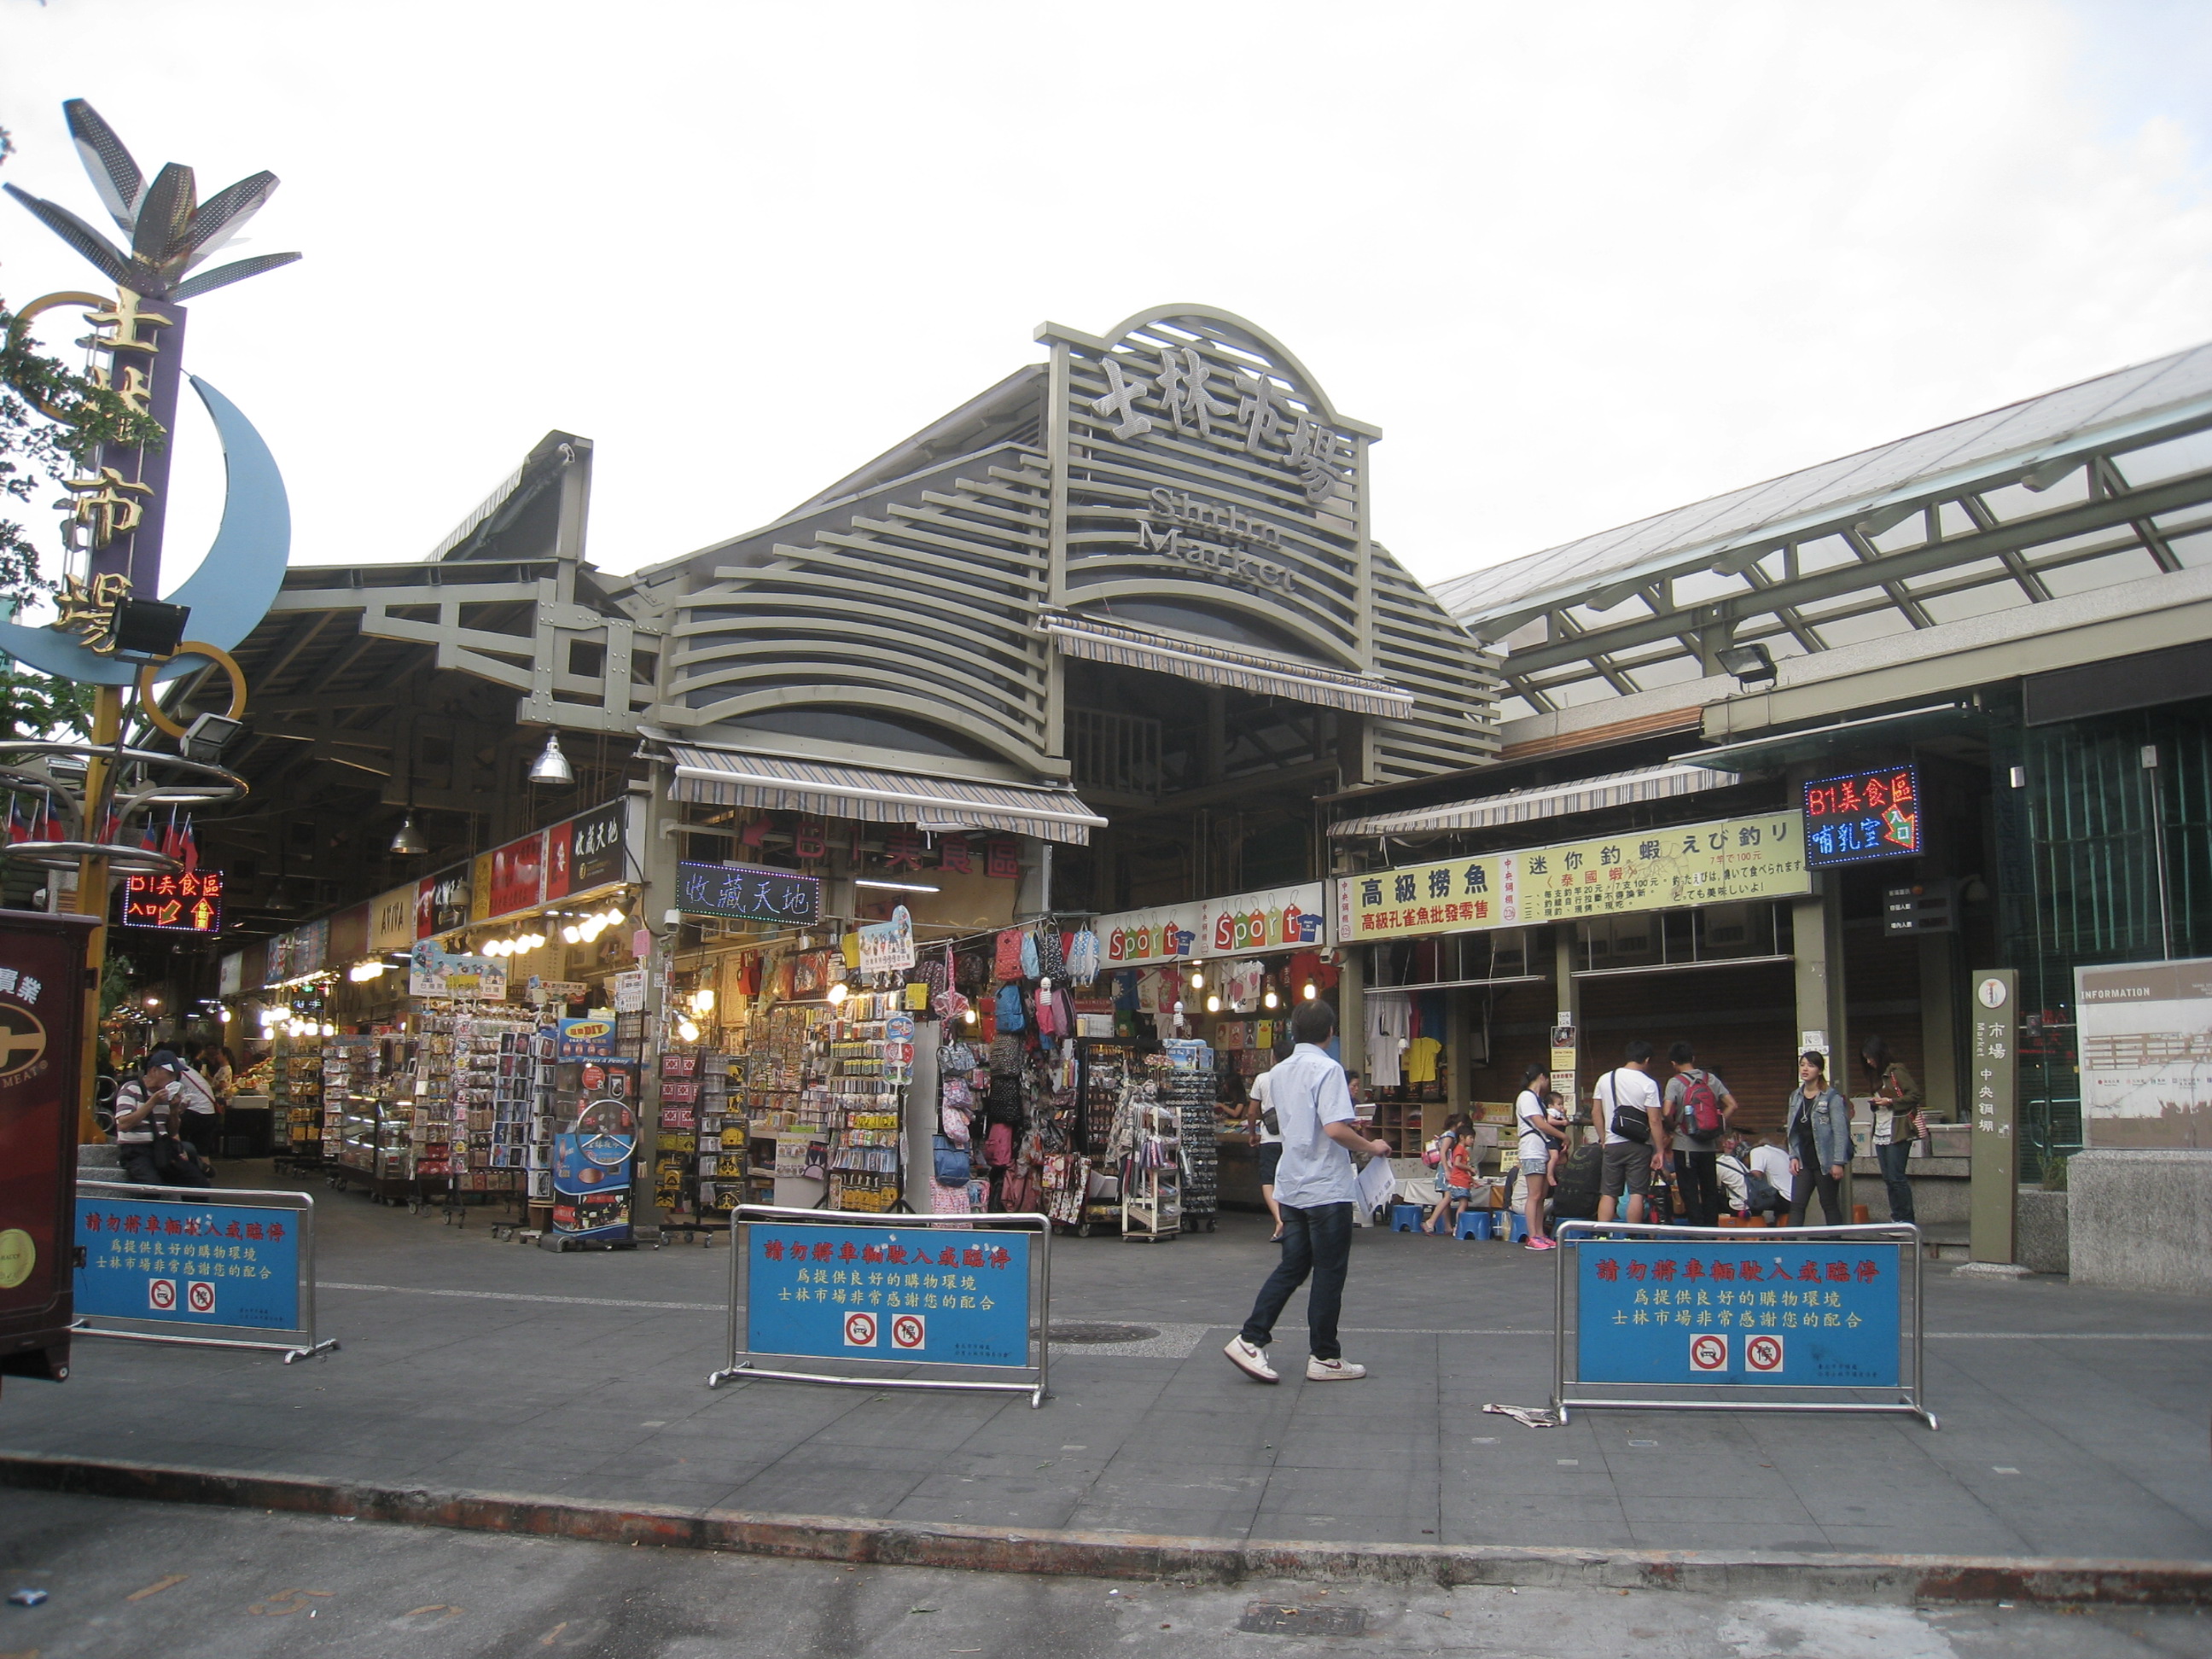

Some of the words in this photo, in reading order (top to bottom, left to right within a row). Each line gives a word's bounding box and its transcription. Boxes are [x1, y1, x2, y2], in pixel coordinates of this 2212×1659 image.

[1090, 346, 1343, 504] 士林市場
[1149, 486, 1283, 549] Shilin
[1136, 518, 1296, 592] Market
[1809, 772, 1913, 816] B1美食區
[574, 816, 620, 857] 收藏天地
[1812, 818, 1881, 854] 哺乳室
[1889, 811, 1909, 840] 入口
[795, 820, 1021, 880] B1美食區
[1528, 839, 1662, 876] 迷你釣蝦
[685, 872, 811, 916] 收藏天地
[1359, 863, 1488, 908] 高級撈魚
[128, 902, 157, 916] 入口
[1360, 899, 1489, 932] 高級孔雀魚批發零售
[1110, 928, 1176, 958] Sport
[1218, 911, 1296, 946] Sport
[2081, 987, 2151, 1000] INFORMATION
[1976, 1022, 1985, 1057] Market
[1988, 1022, 2006, 1060] 市場
[2, 1068, 38, 1089] MEAT
[96, 1255, 272, 1280] 士林市場非常感謝您的配合
[763, 1240, 1013, 1271] 請勿將車輛駛入或臨停
[1594, 1258, 1881, 1285] 請勿將車輛駛入或臨停
[777, 1287, 997, 1313] 士林市場非常感謝您的配合
[901, 1324, 917, 1340] 停
[1611, 1308, 1864, 1330] 士林市場非常感謝您的配合
[1756, 1345, 1774, 1362] 停
